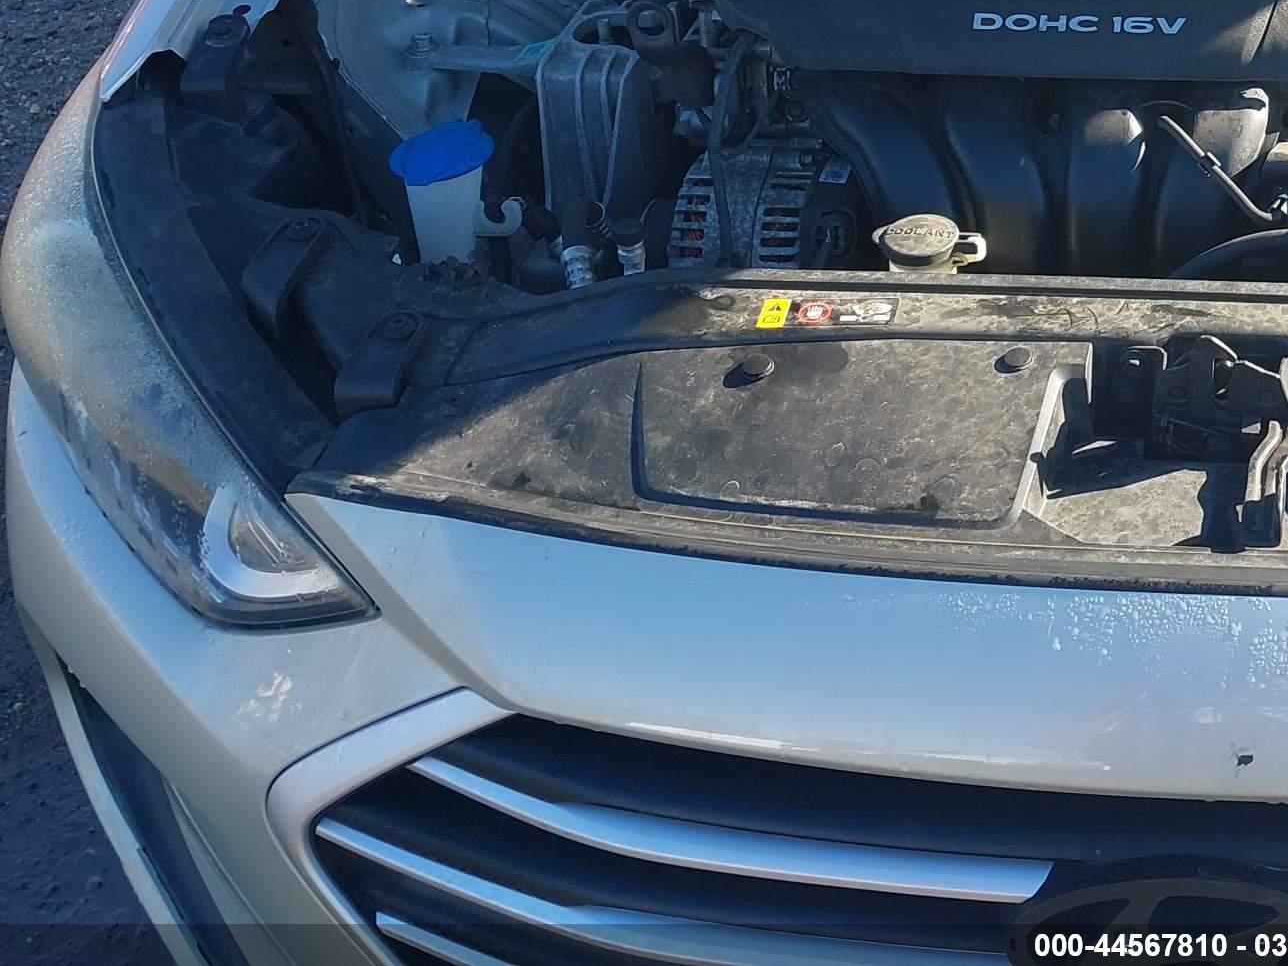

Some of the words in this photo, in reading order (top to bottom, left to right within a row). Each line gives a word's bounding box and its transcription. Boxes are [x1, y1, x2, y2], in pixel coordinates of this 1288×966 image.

[973, 13, 1099, 32] DOHC
[1113, 16, 1187, 34] 16V
[886, 226, 955, 239] COOLANT
